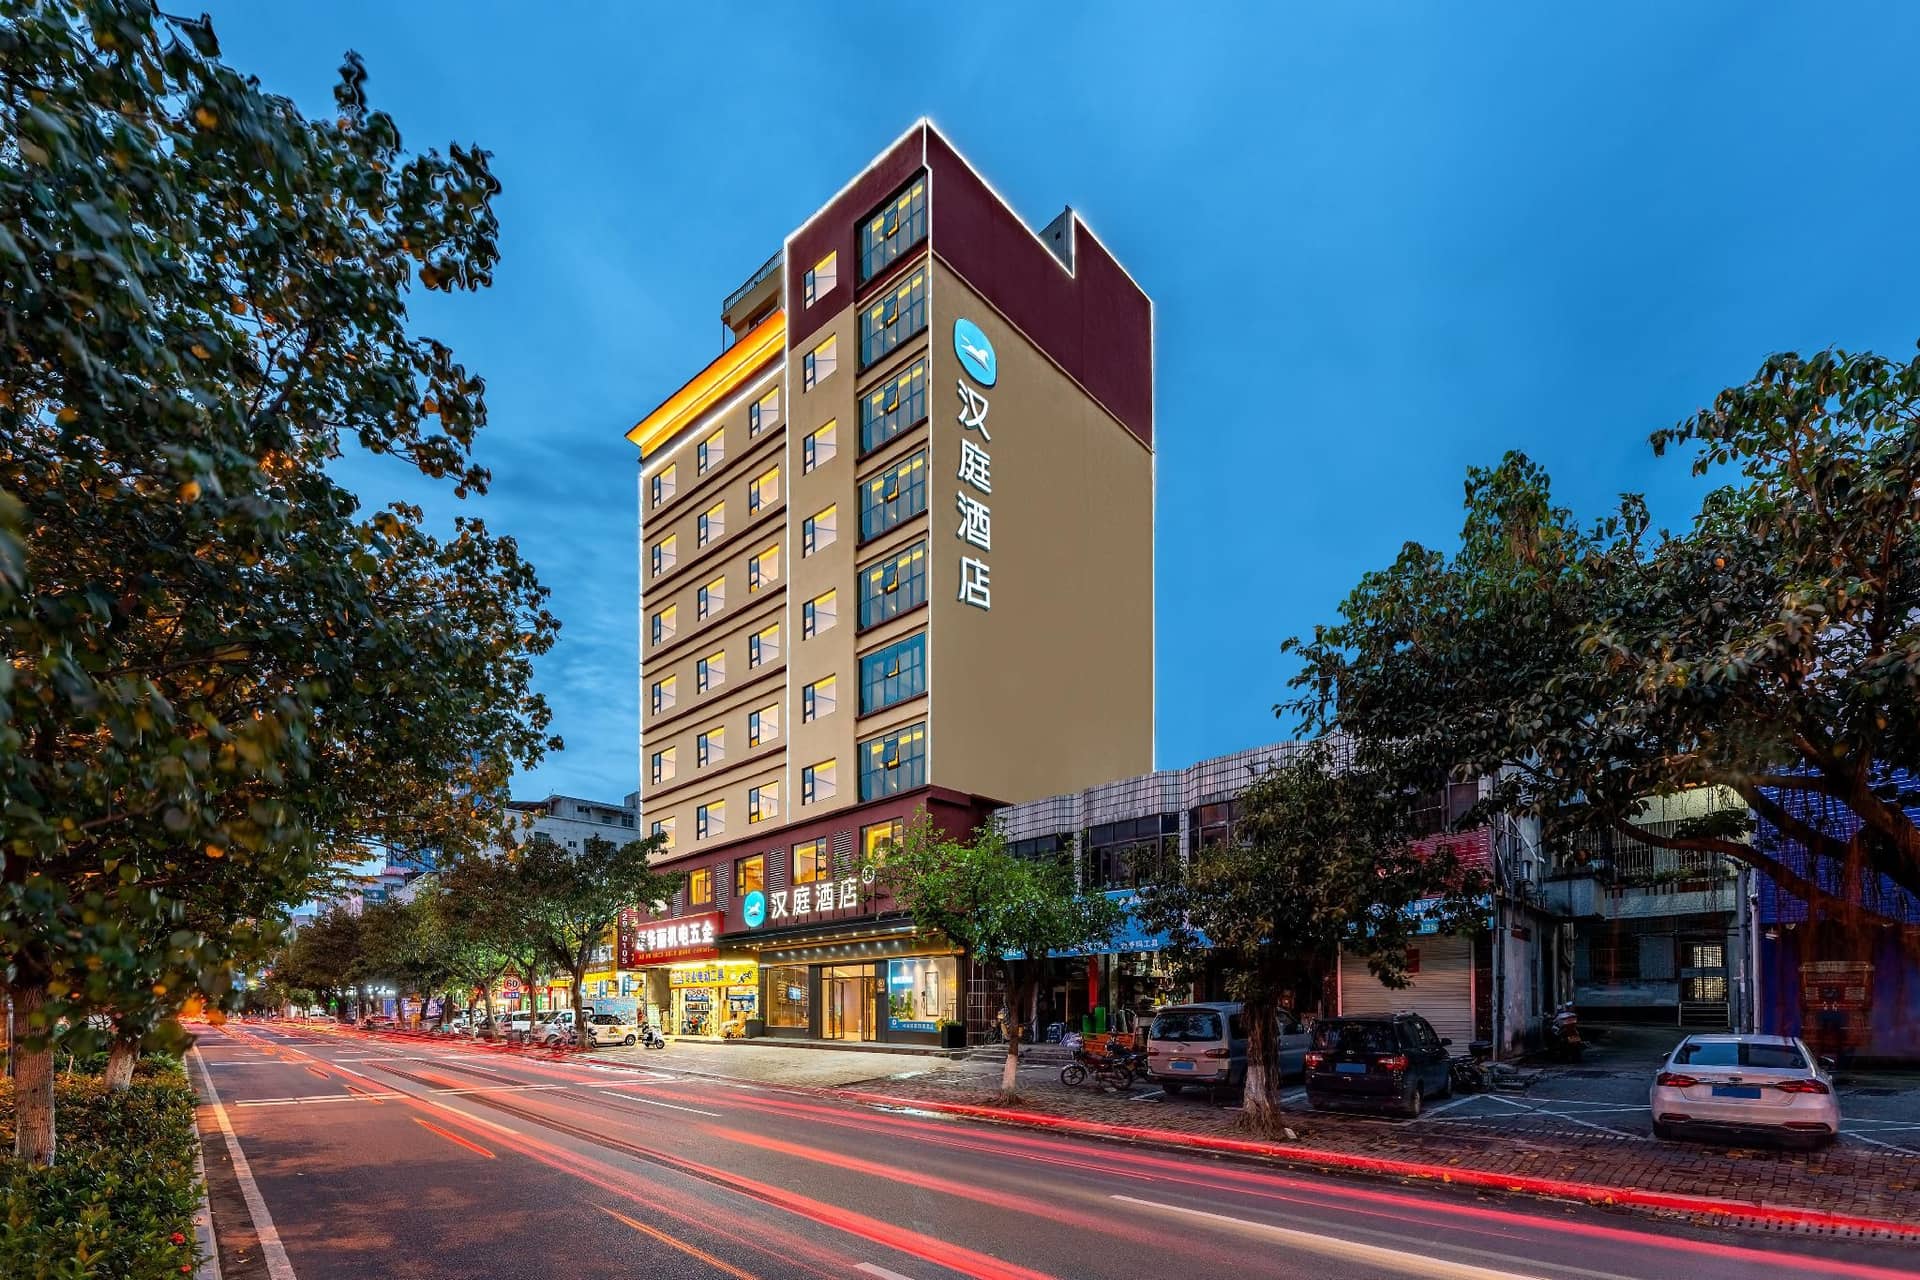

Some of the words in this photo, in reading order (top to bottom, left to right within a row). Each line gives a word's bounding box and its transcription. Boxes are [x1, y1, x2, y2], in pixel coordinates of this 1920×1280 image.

[957, 379, 992, 610] 汉庭酒店
[771, 877, 857, 919] 汉庭酒店
[506, 979, 518, 988] 60
